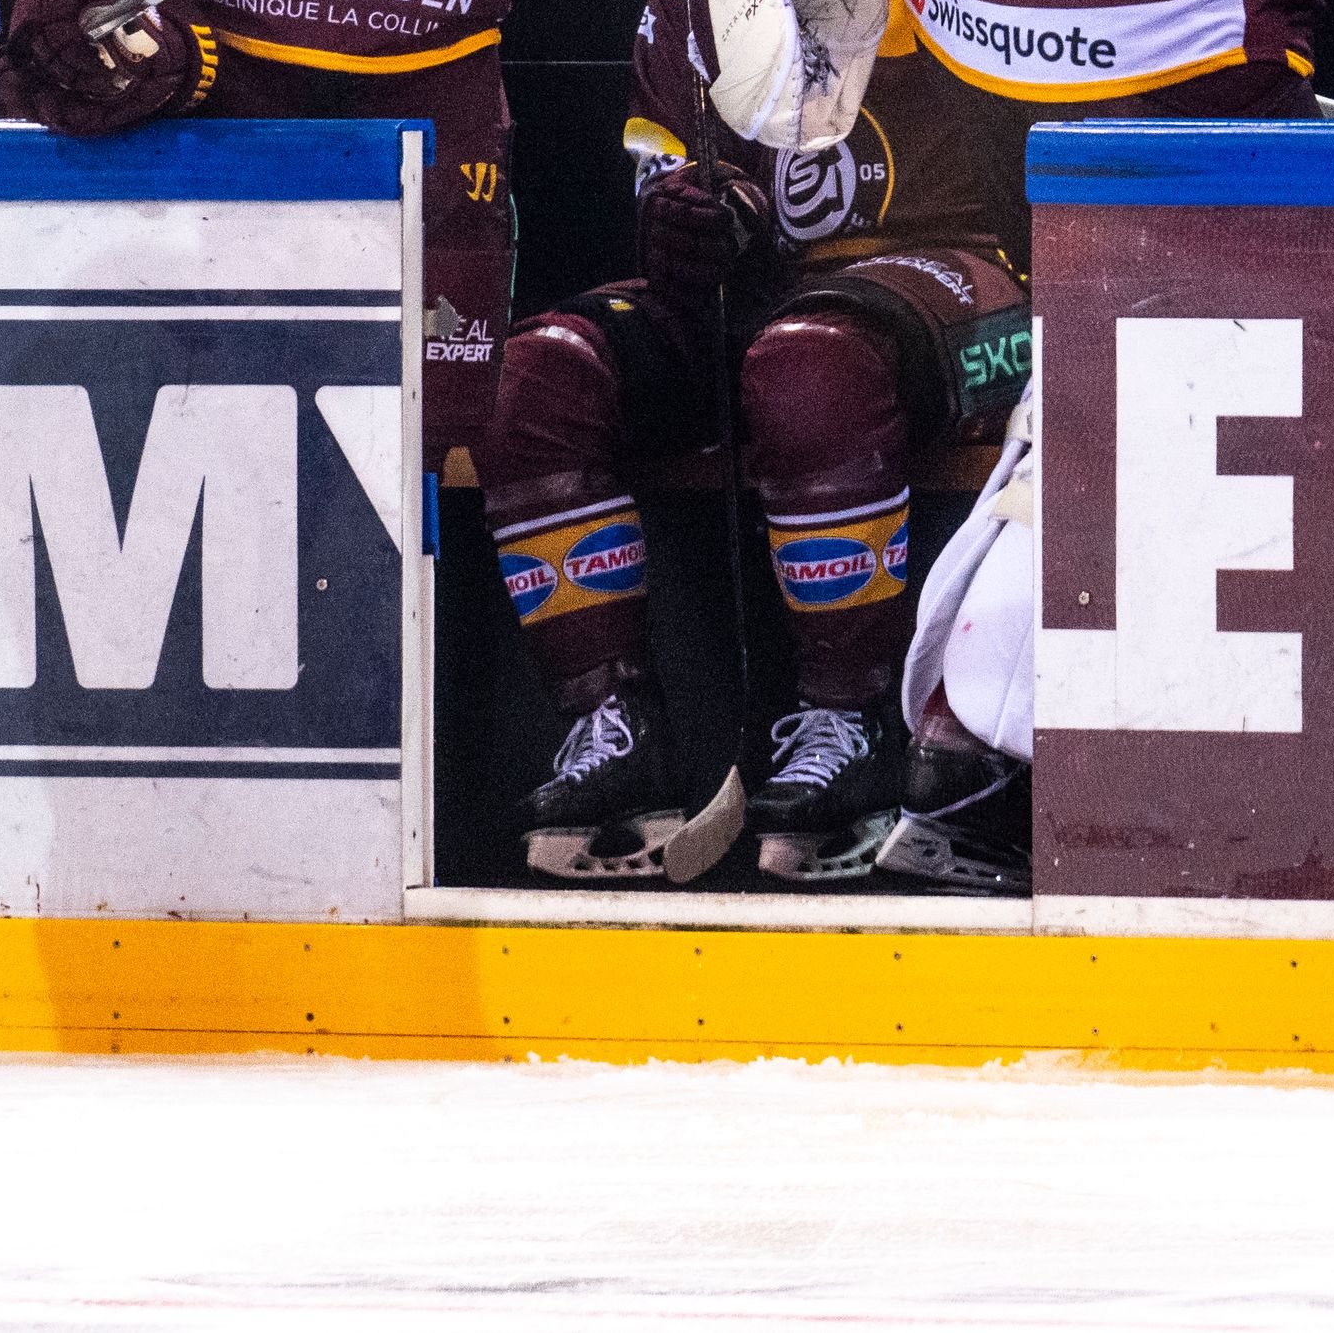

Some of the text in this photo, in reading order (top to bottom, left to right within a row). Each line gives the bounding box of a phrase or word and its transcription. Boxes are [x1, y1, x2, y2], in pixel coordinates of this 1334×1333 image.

[327, 4, 359, 26] LA
[859, 164, 886, 182] 05
[425, 342, 494, 363] EXPERT
[959, 330, 1033, 388] SKO
[1034, 317, 1304, 734] E
